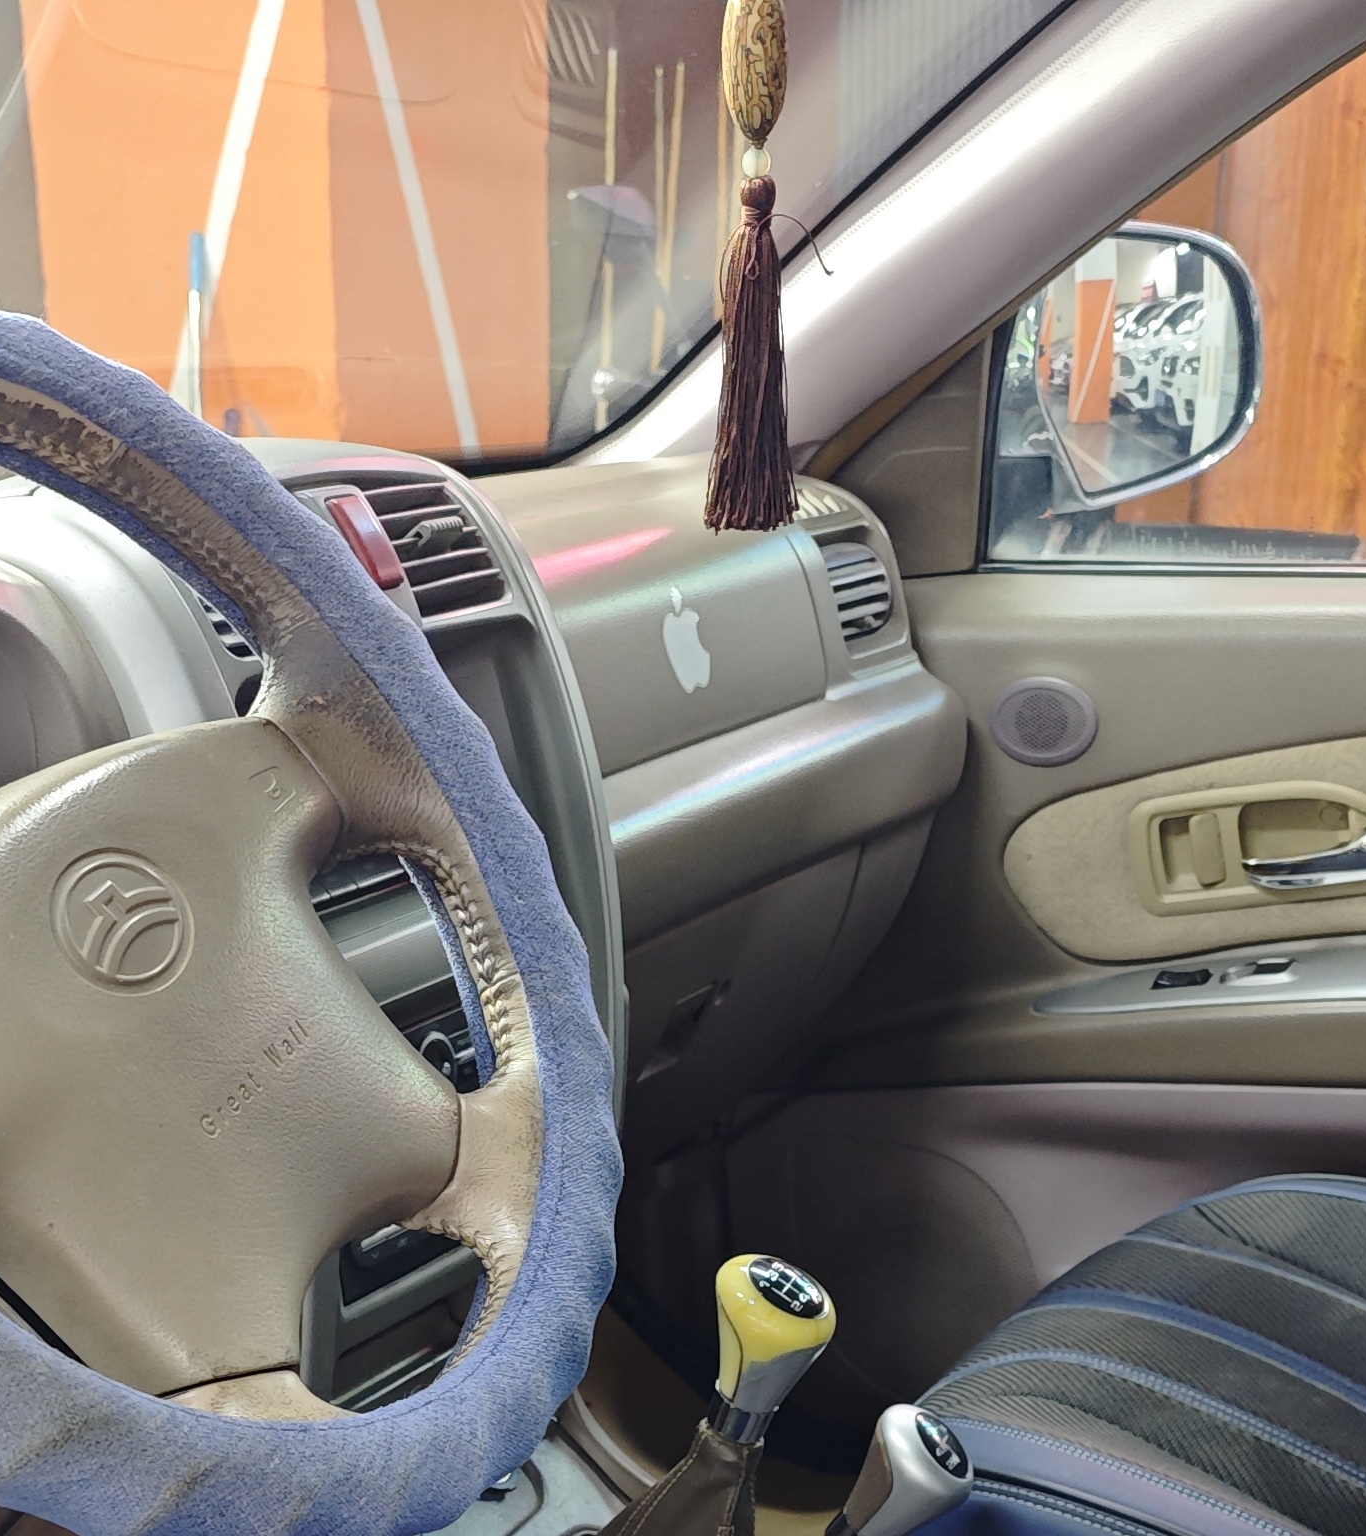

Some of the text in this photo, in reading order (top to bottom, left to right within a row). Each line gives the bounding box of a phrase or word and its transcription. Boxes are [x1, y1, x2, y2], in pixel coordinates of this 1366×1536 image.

[199, 1019, 309, 1139] Great Wall
[790, 1299, 804, 1312] 2
[798, 1292, 811, 1303] 4
